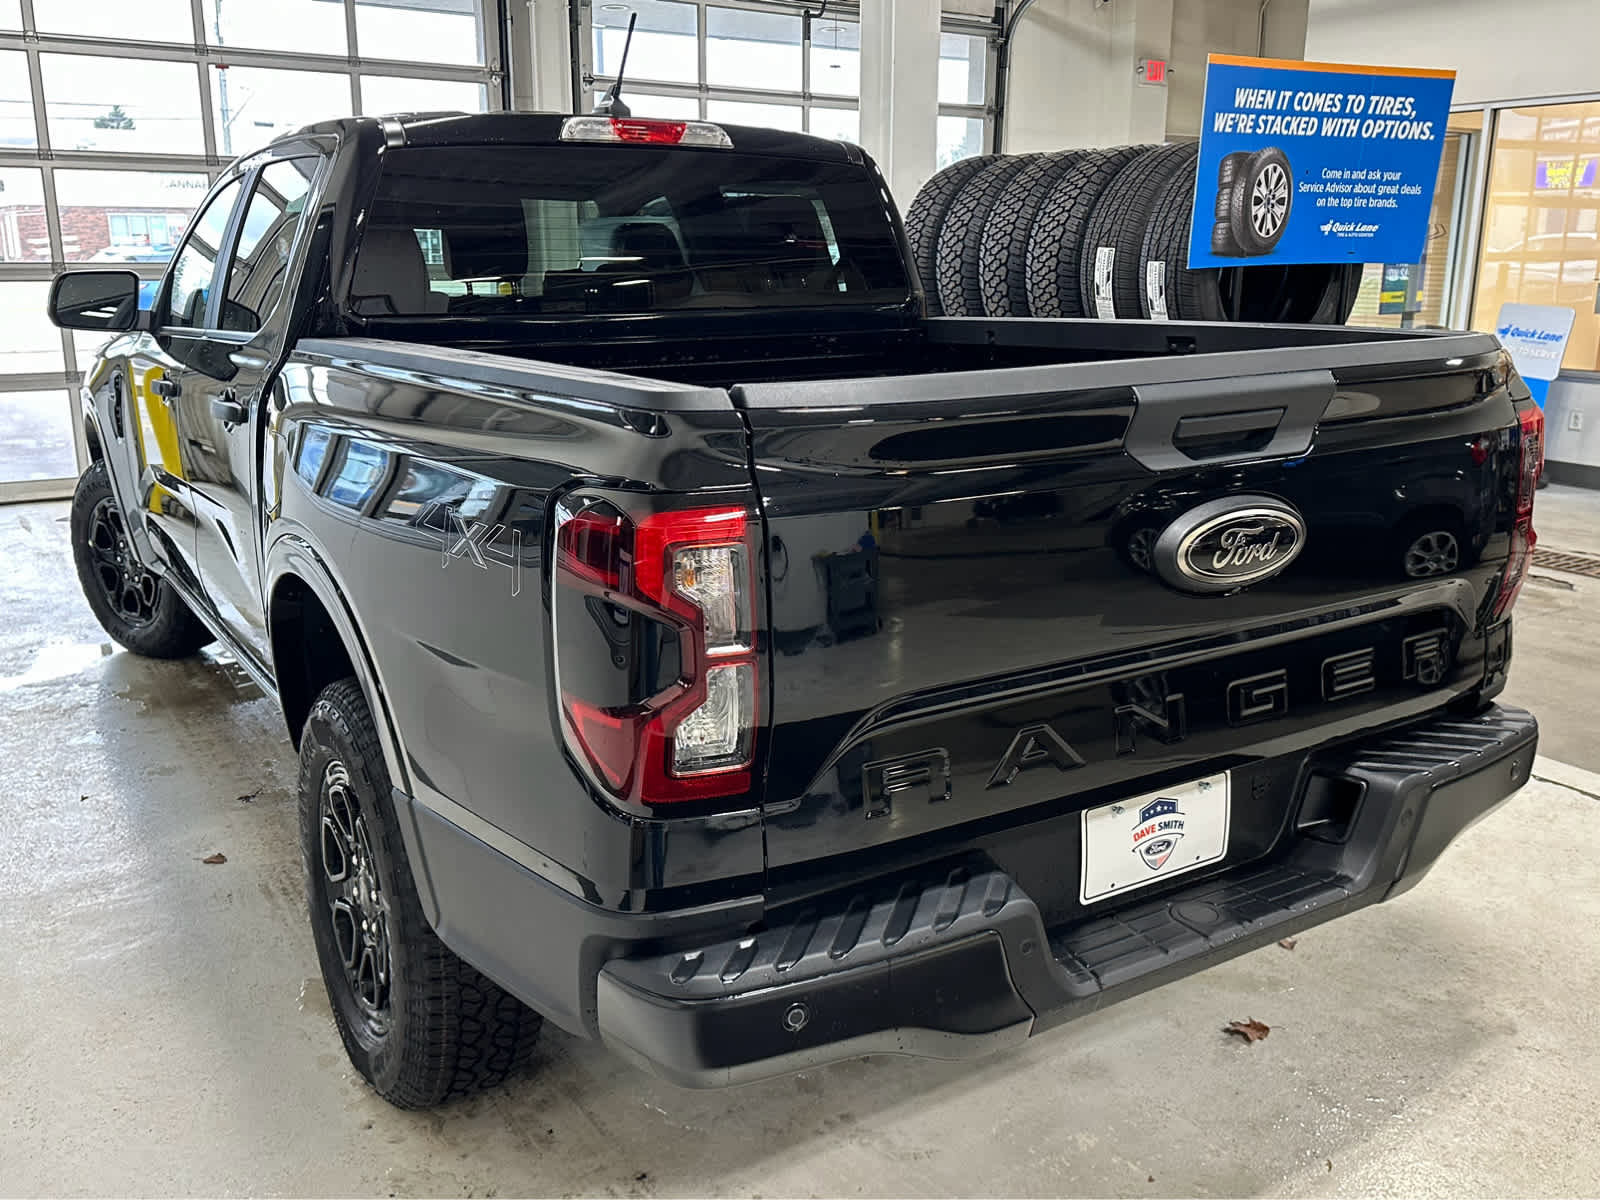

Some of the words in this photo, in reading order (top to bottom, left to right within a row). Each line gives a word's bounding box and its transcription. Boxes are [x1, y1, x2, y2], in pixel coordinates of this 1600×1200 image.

[1234, 87, 1275, 110] WHEN
[1276, 90, 1293, 111] IT
[1293, 91, 1343, 113] COMES
[1345, 94, 1366, 114] TO
[1367, 95, 1416, 119] TIRES,
[1213, 112, 1256, 134] WE'RE
[1255, 114, 1319, 137] STACKED
[1320, 117, 1360, 138] WITH
[1361, 119, 1436, 140] OPTIONS.
[1322, 168, 1342, 179] Come
[1343, 168, 1350, 179] in
[1351, 168, 1367, 180] and
[1367, 169, 1381, 180] ask
[1382, 171, 1402, 182] your
[1298, 181, 1325, 193] Service
[1324, 182, 1353, 194] Advisor
[1353, 183, 1377, 194] about
[1377, 184, 1399, 195] great
[1400, 184, 1422, 195] deals
[1316, 197, 1326, 207] on
[1327, 196, 1340, 207] the
[1340, 197, 1353, 209] top
[1353, 197, 1368, 208] tire
[1368, 197, 1398, 209] brands.
[1332, 222, 1356, 233] Quick
[1355, 222, 1379, 232] Lane
[1510, 327, 1537, 338] Quick
[1536, 330, 1563, 342] Lane
[1212, 525, 1281, 569] Ford
[861, 627, 1450, 820] RANGER
[1133, 824, 1156, 842] DAVE
[1157, 820, 1184, 831] SMITH
